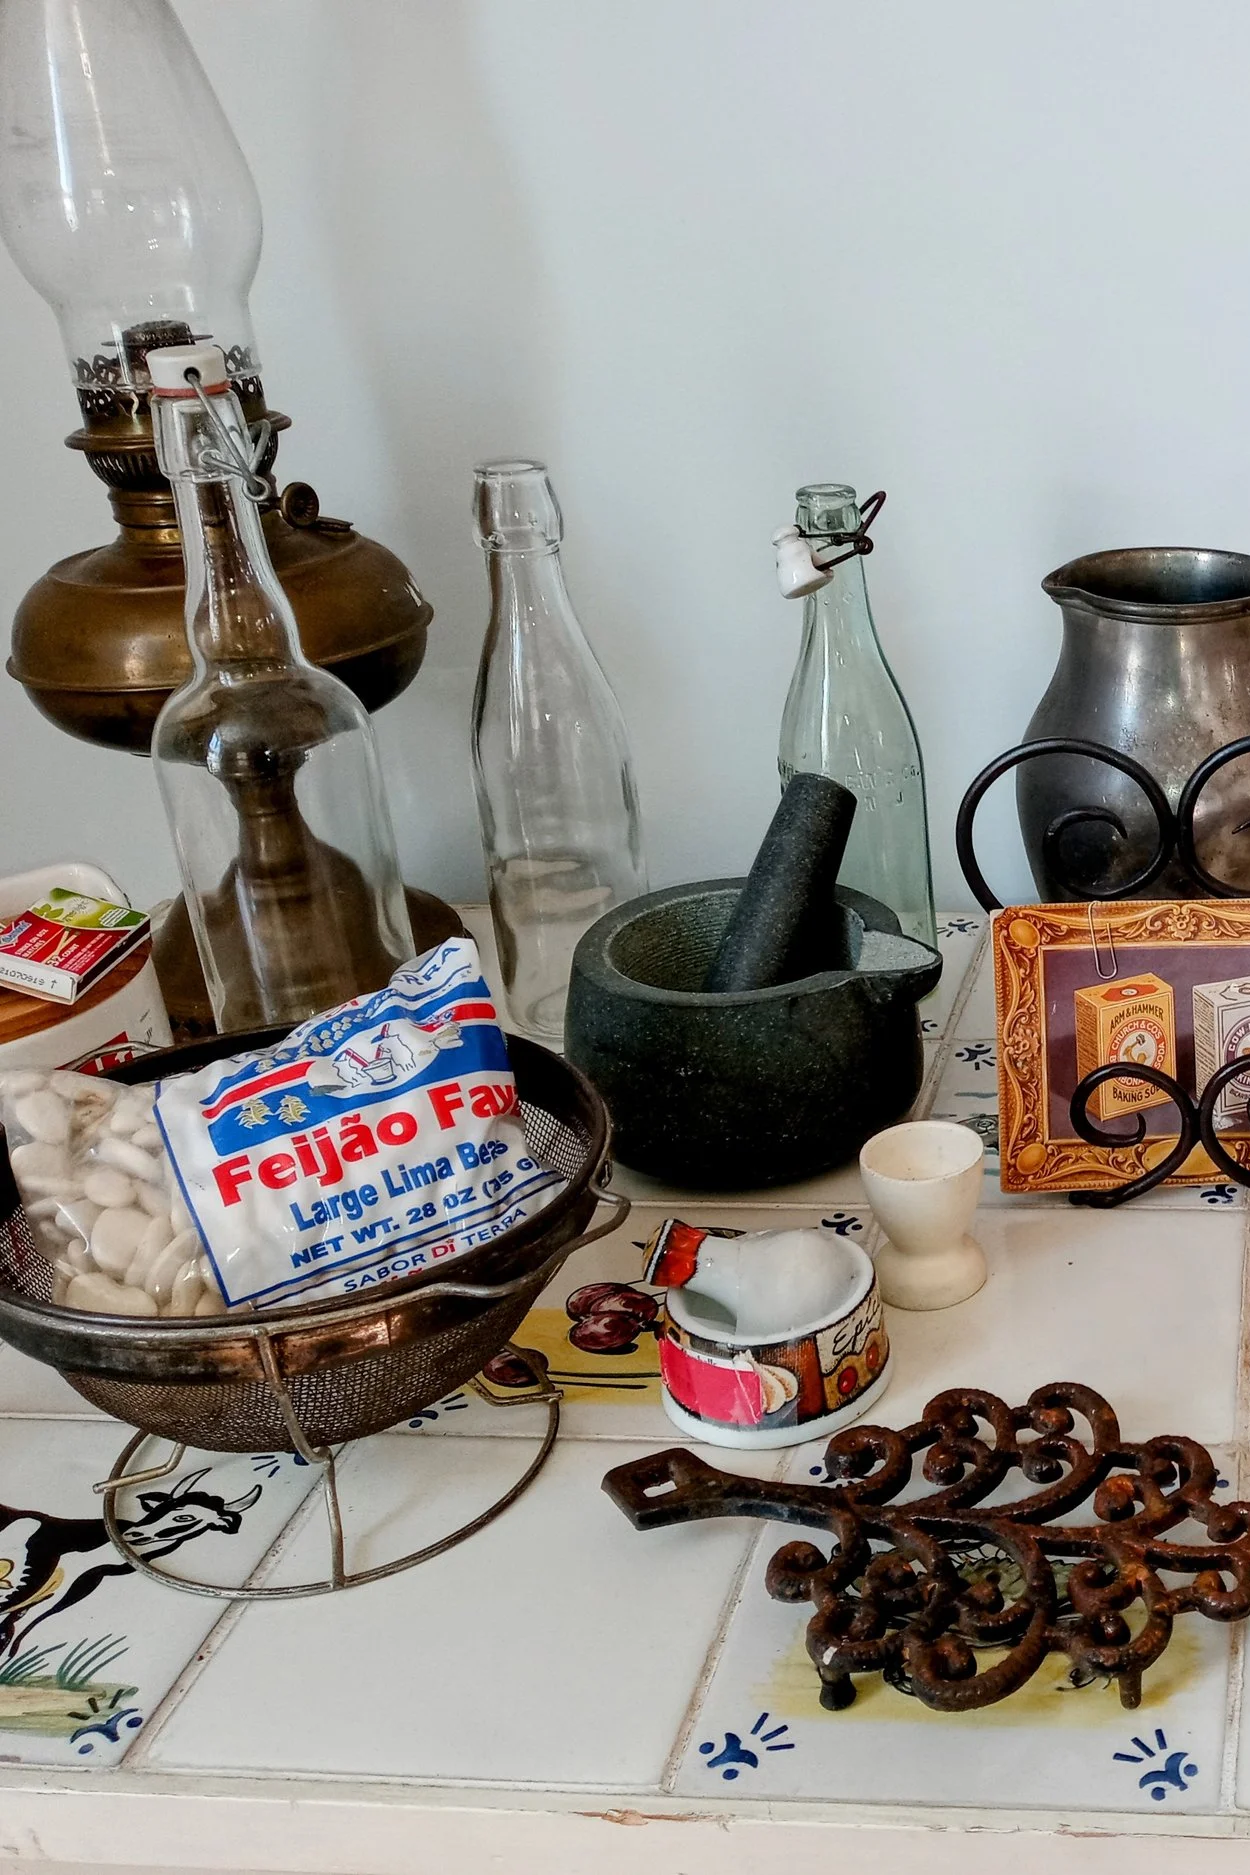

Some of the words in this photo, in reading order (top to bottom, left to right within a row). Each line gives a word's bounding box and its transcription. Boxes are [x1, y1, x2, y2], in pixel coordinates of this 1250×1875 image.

[45, 954, 62, 967] 32
[1109, 1010, 1125, 1034] ARM
[1125, 1007, 1132, 1018] &
[1132, 1003, 1164, 1021] HAMMER
[1111, 1020, 1139, 1051] CHURCH
[1228, 1028, 1245, 1052] COW
[1112, 1086, 1143, 1103] BAKING
[1144, 1084, 1161, 1099] SO
[211, 1111, 418, 1208] Feijão
[289, 1184, 379, 1231] Large
[381, 1156, 455, 1199] Lima
[290, 1234, 345, 1269] NET
[351, 1217, 401, 1245] WT.
[406, 1202, 437, 1225] 28
[442, 1186, 477, 1209] OZ
[344, 1253, 427, 1293] SABOR
[461, 1208, 527, 1247] TERRA
